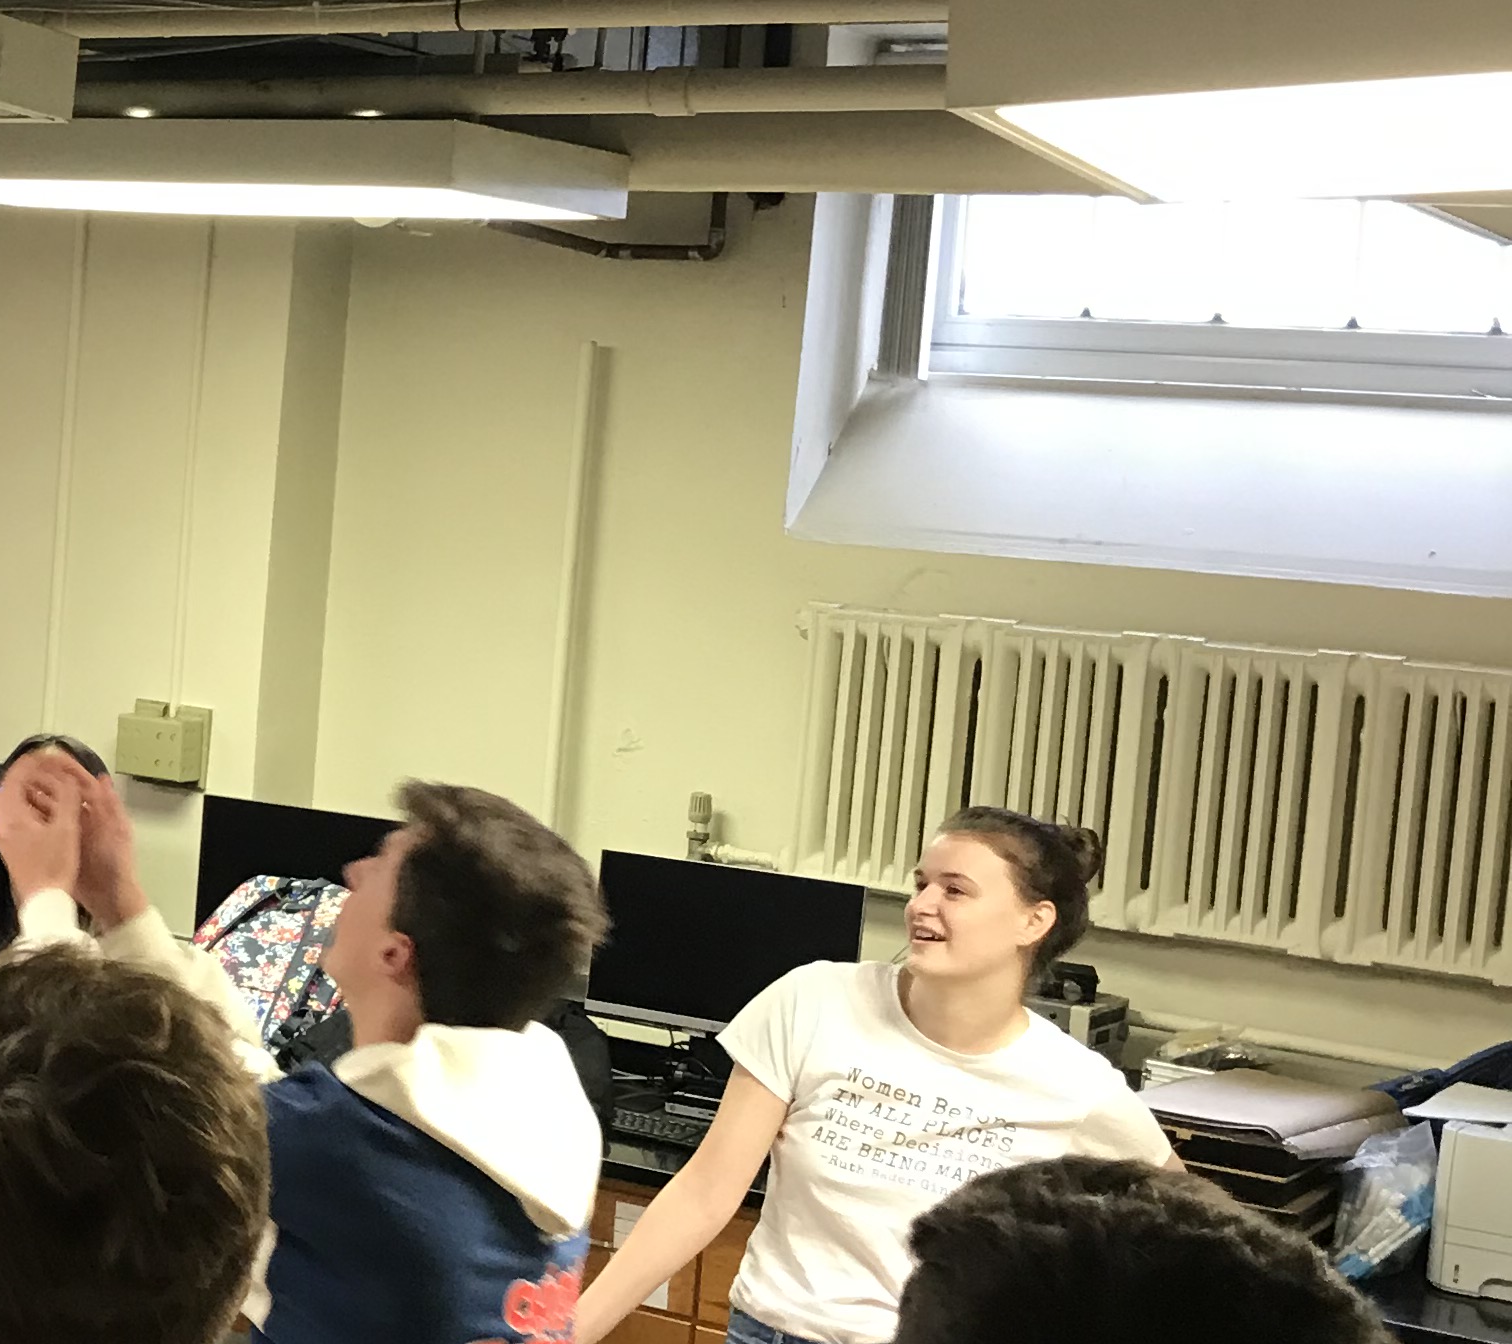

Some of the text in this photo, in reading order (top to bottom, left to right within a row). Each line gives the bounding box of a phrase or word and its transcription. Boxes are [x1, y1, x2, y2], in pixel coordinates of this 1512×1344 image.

[847, 1067, 922, 1108] Women
[824, 1107, 1003, 1169] Where Decisions
[832, 1088, 1013, 1152] IN ALL PLACES
[811, 1126, 979, 1183] ARE BEING MAD
